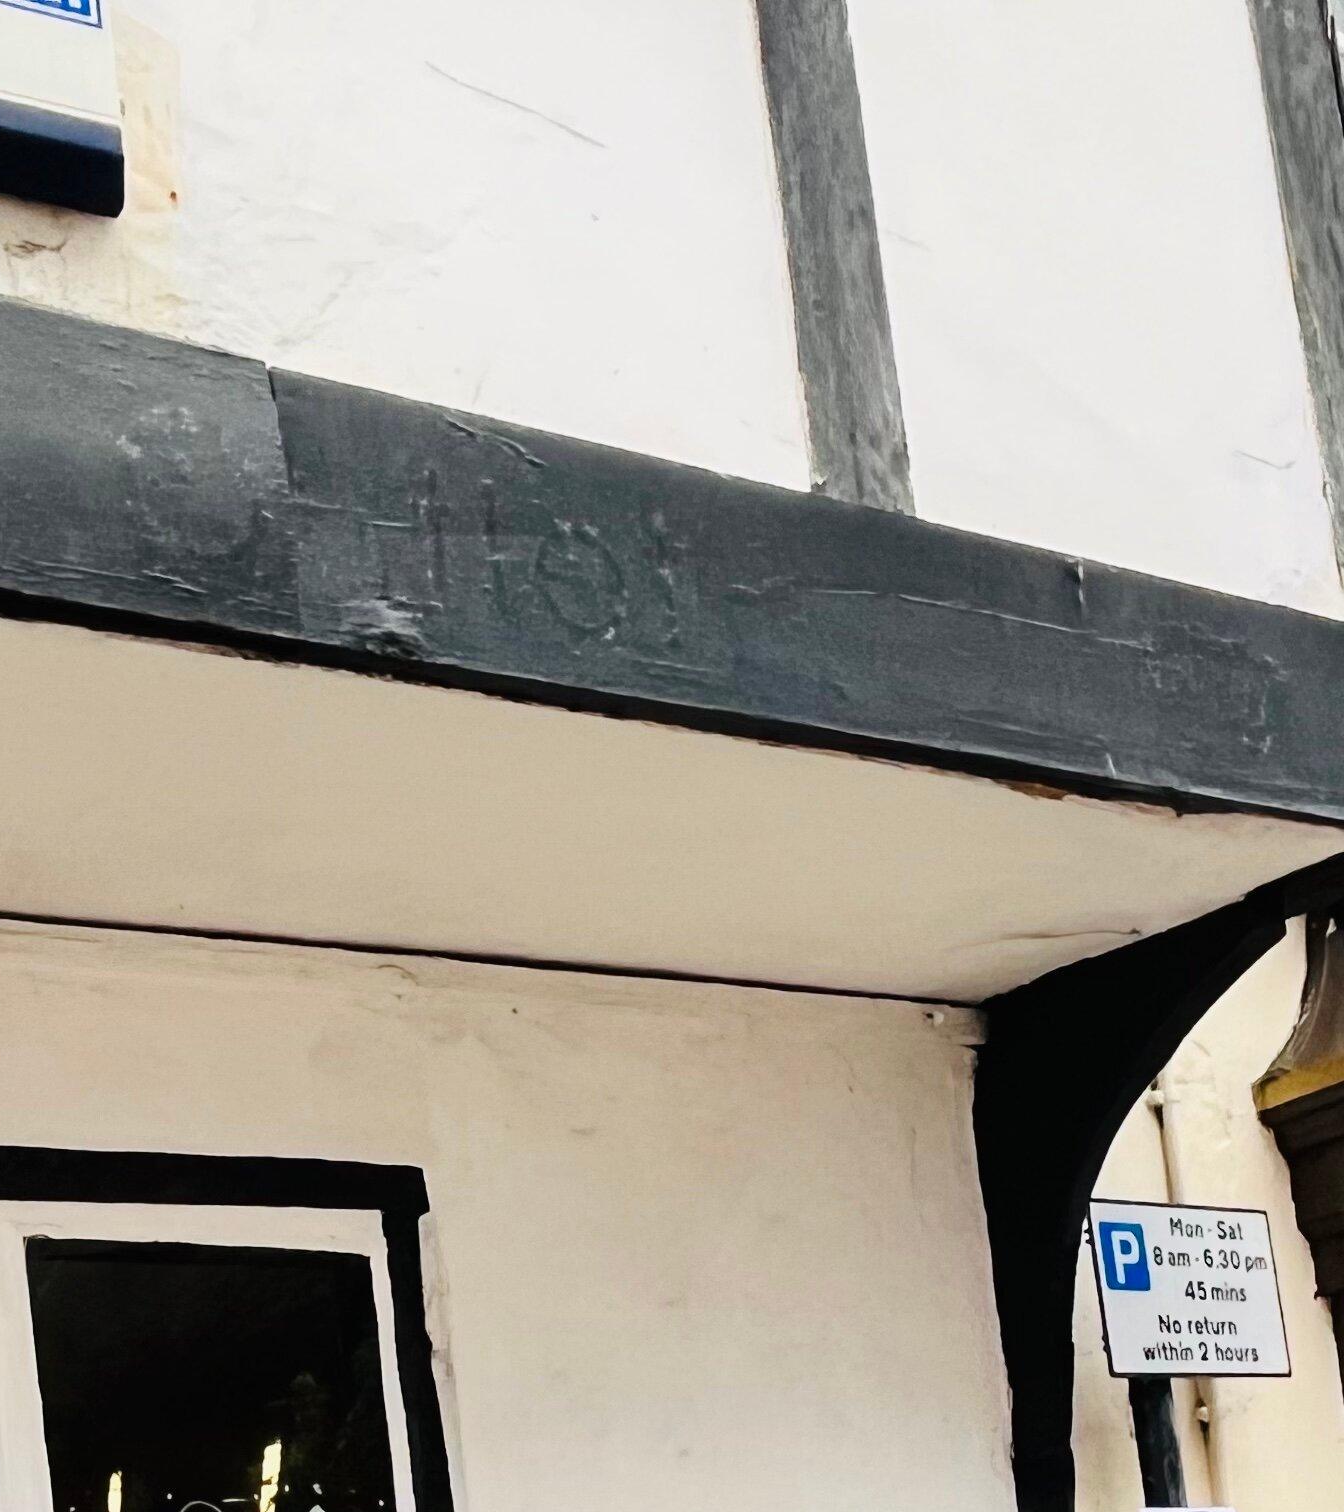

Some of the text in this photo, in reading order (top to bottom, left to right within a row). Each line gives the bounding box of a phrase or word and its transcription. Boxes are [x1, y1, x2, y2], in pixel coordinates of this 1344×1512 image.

[1169, 1217, 1204, 1239] Mon
[1217, 1220, 1244, 1241] Sat
[1110, 1230, 1140, 1285] P
[1153, 1246, 1163, 1266] 8
[1168, 1251, 1191, 1267] am
[1204, 1248, 1240, 1270] 6.30
[1245, 1255, 1268, 1273] pm
[1185, 1281, 1247, 1302] 45 mins
[1158, 1314, 1238, 1336] No return
[1143, 1341, 1259, 1363] within 2 hours
